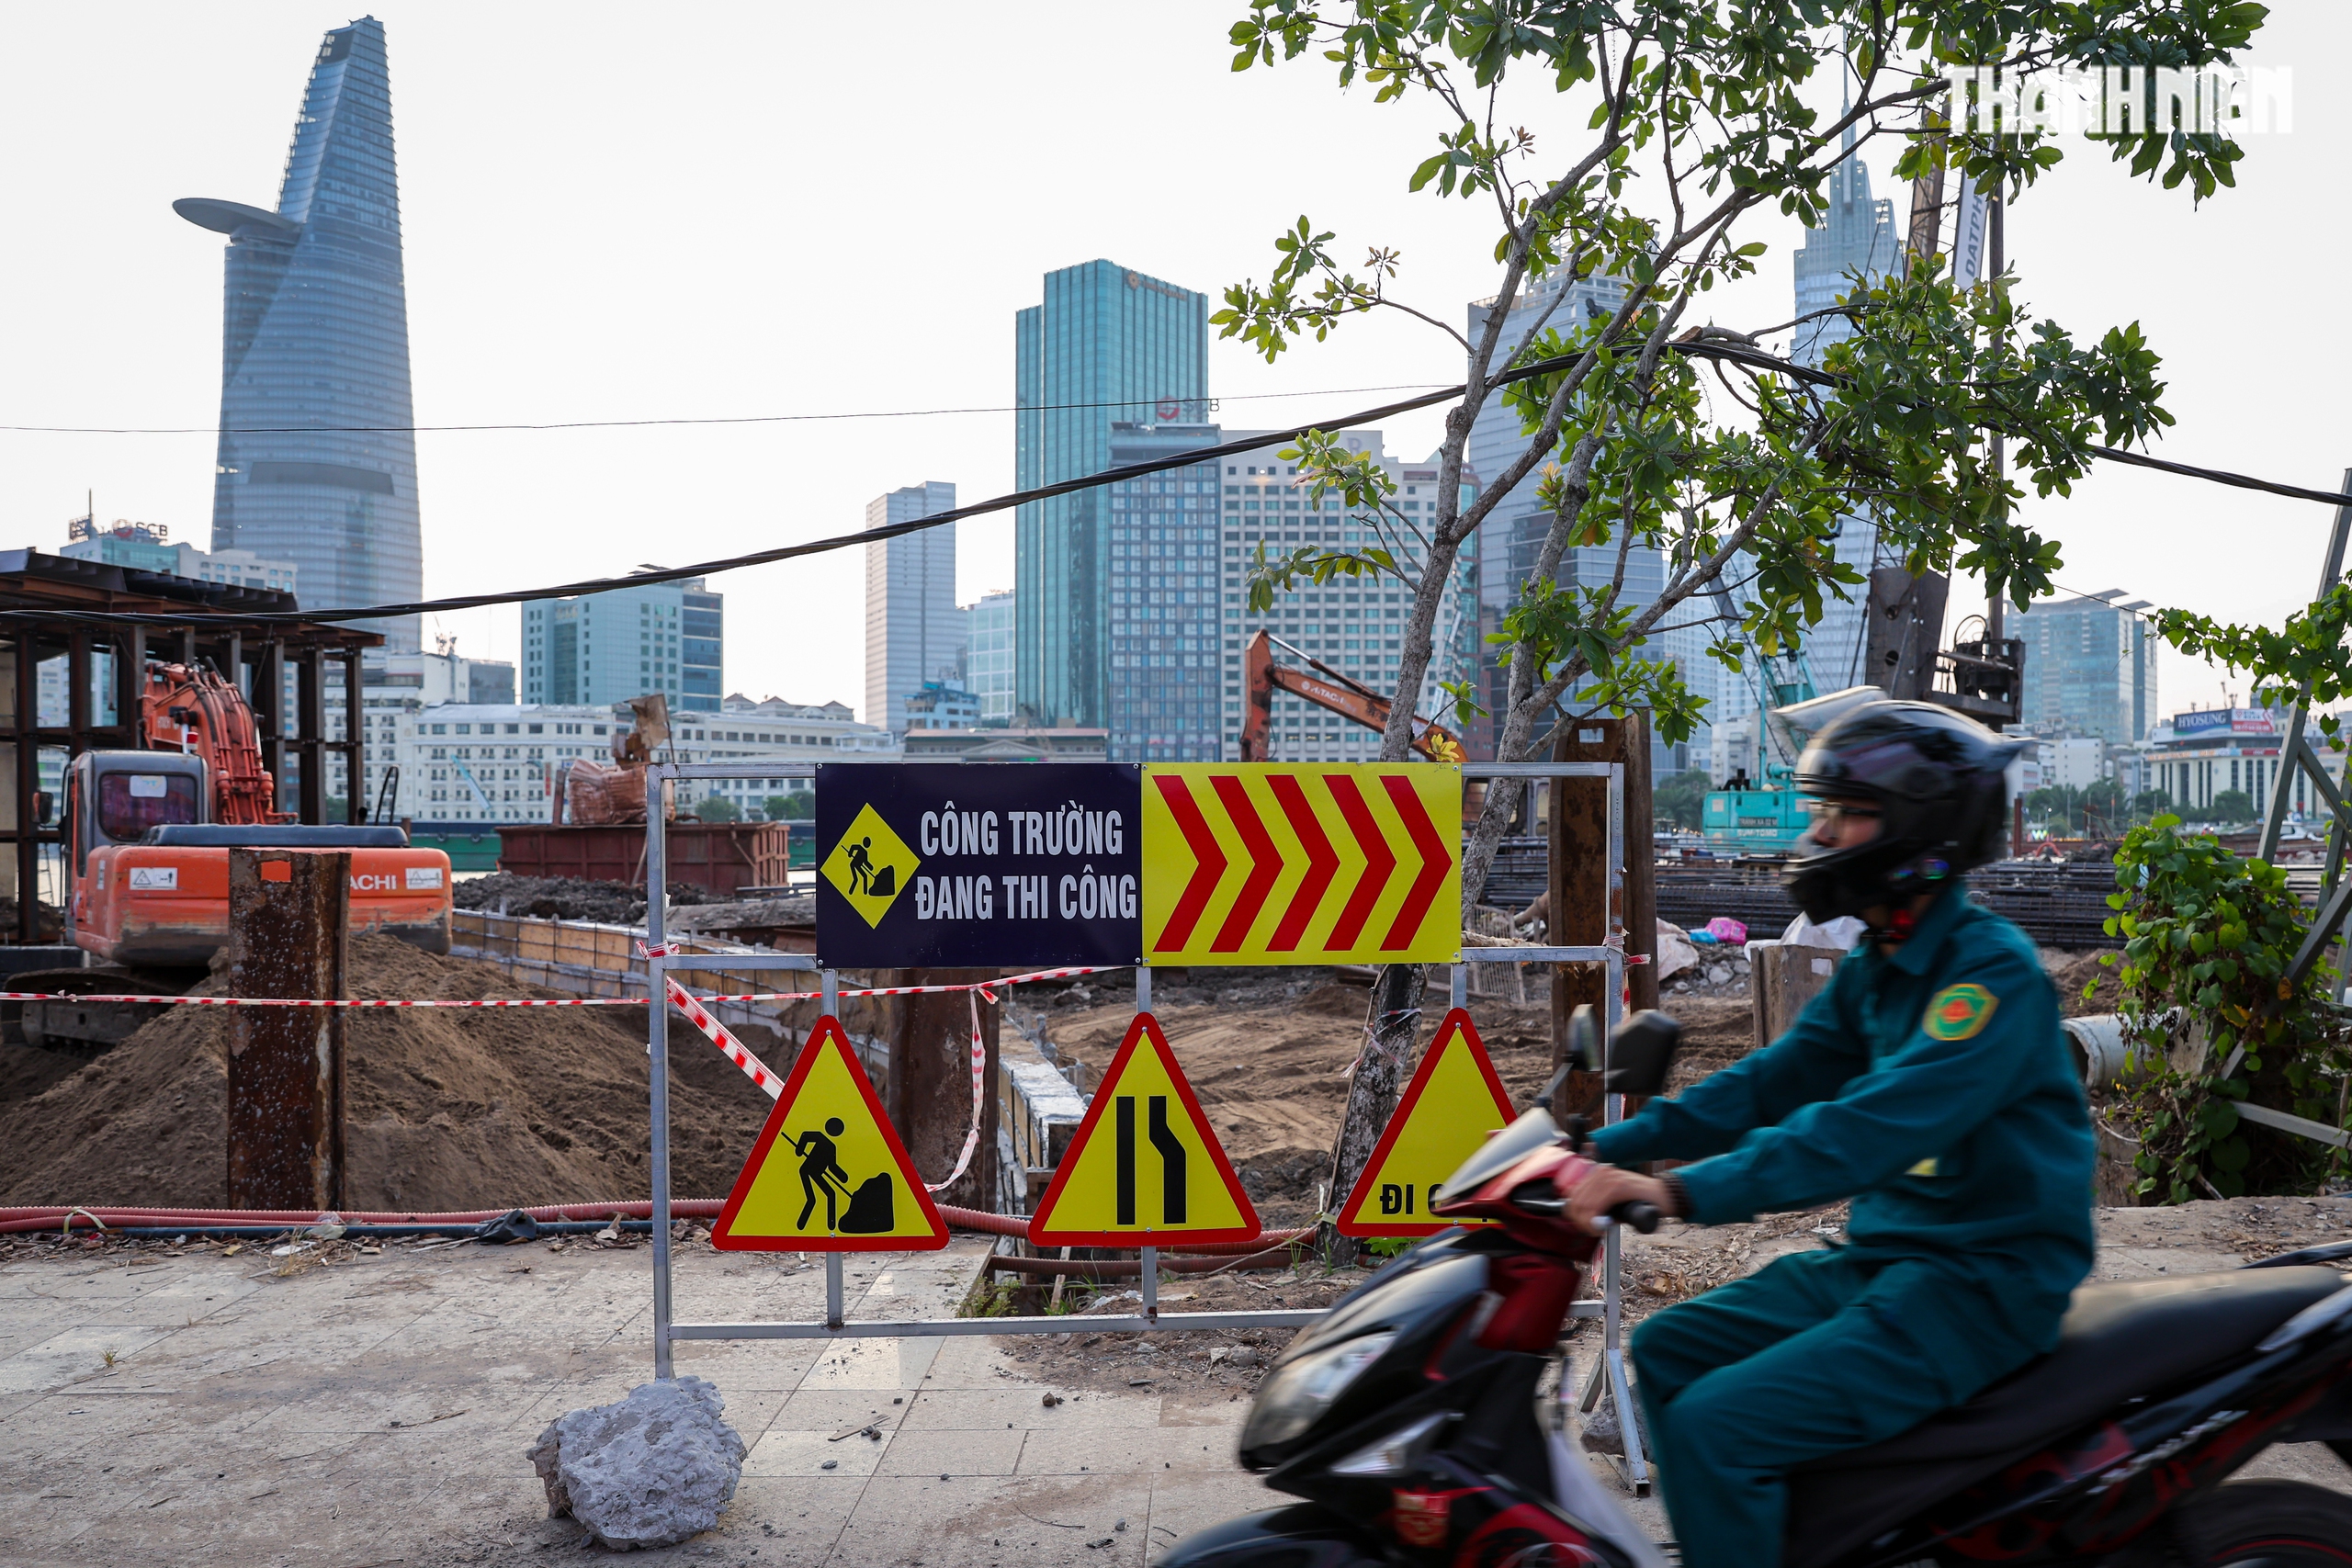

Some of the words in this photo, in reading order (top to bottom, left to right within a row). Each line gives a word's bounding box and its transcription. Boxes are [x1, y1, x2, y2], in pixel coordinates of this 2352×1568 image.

[135, 522, 168, 536] SCB
[2178, 712, 2226, 728] HYOSUNG
[921, 800, 999, 856] CÔNG
[1008, 799, 1123, 856] TRƯỜNG
[915, 874, 993, 920] ĐANG
[1002, 875, 1048, 919] THI
[1059, 863, 1136, 919] CÔNG
[1379, 1183, 1415, 1215] ĐI
